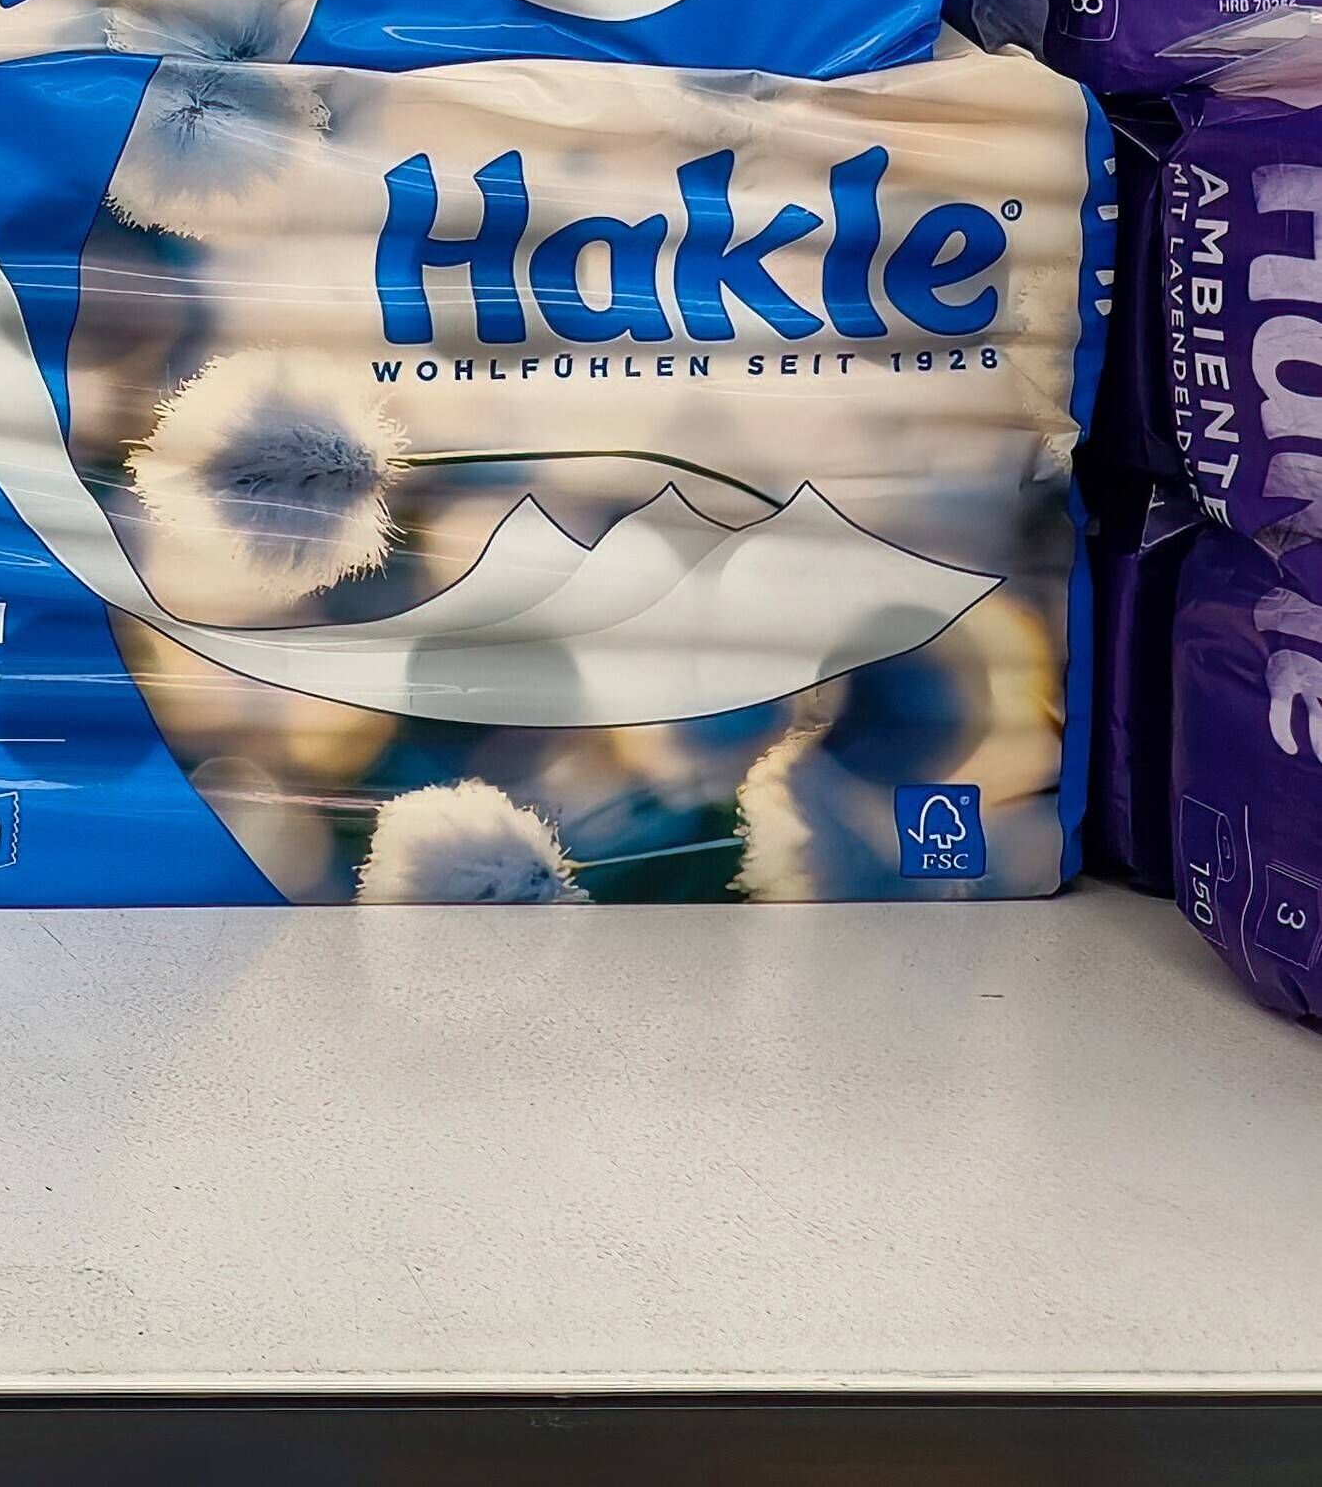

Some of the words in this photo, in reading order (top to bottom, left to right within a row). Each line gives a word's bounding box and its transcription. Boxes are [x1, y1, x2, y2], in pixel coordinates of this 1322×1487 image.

[1168, 162, 1189, 222] MIT
[373, 354, 711, 384] WOHLFÜHLEN
[748, 354, 853, 375] SEIT
[890, 348, 999, 374] 1928
[1190, 164, 1239, 529] AMBIENTE
[923, 853, 969, 870] FSC
[1189, 861, 1213, 926] 150
[1277, 902, 1306, 930] 3
